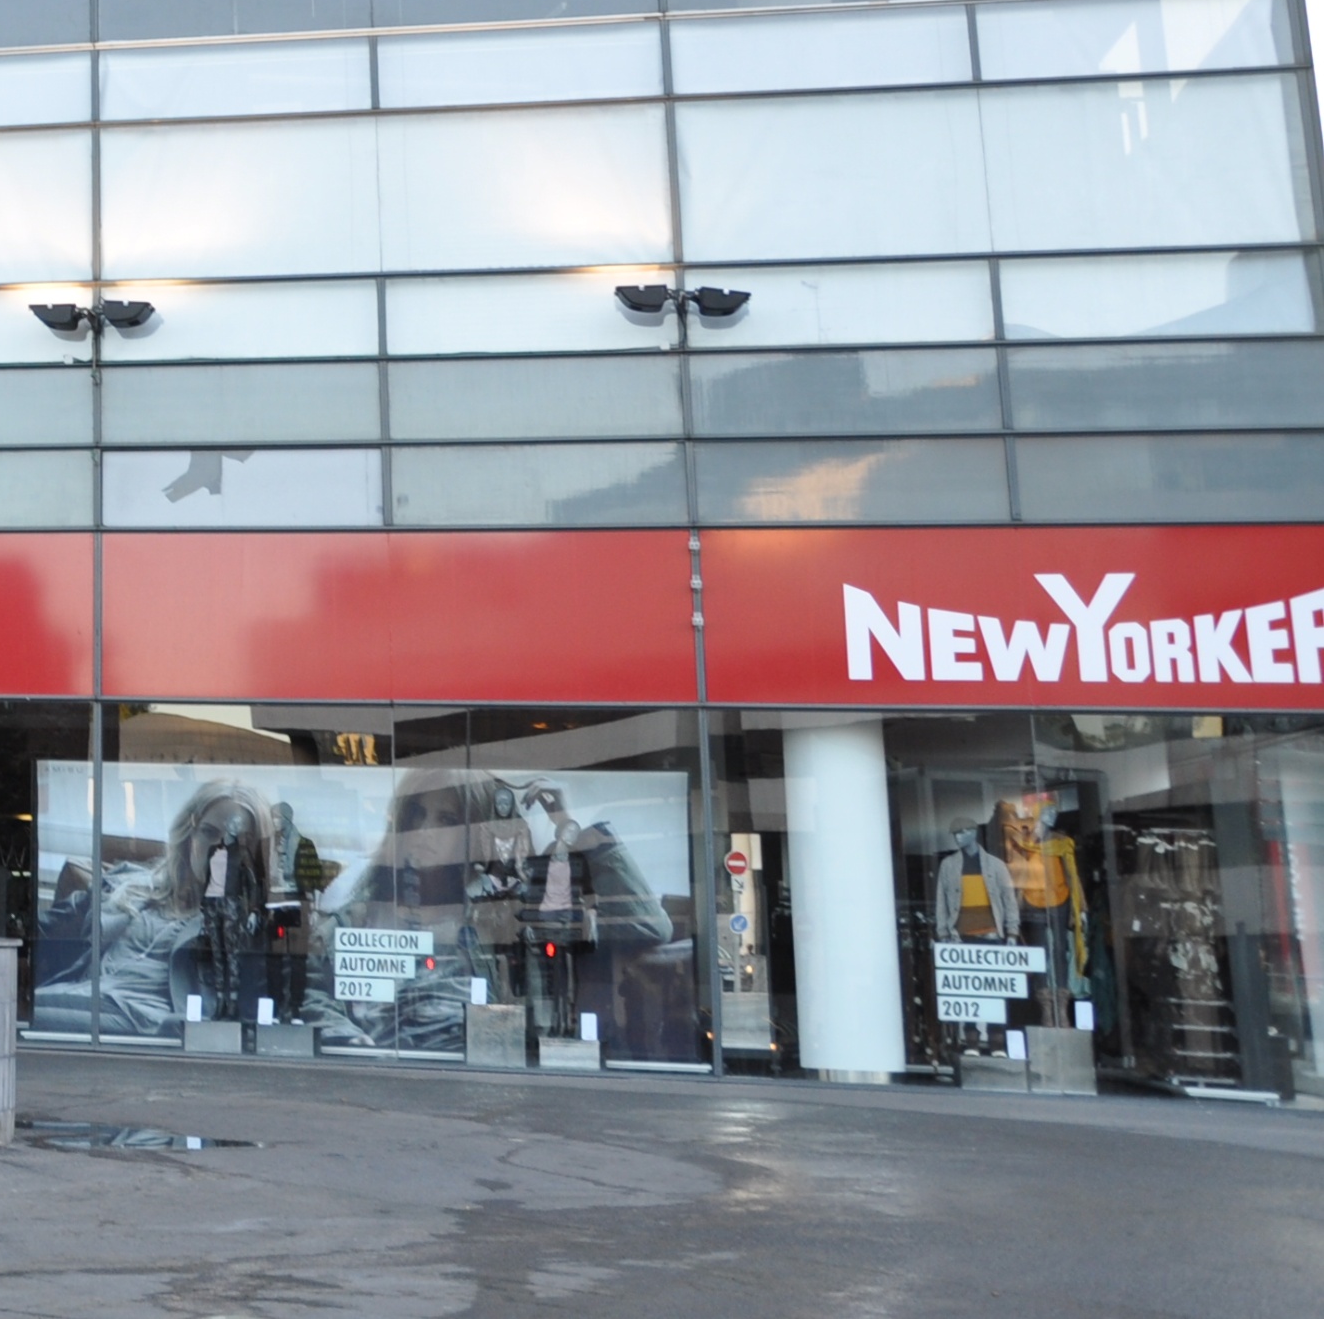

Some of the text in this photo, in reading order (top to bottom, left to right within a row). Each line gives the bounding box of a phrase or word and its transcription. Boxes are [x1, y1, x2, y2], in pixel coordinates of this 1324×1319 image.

[339, 931, 420, 951] COLLECTION
[339, 957, 407, 975] AUTOMNE
[939, 947, 1030, 967] COLLECTION
[339, 980, 373, 997] 2012
[941, 973, 1018, 994] AUTOMNE
[942, 1000, 981, 1018] 2012
